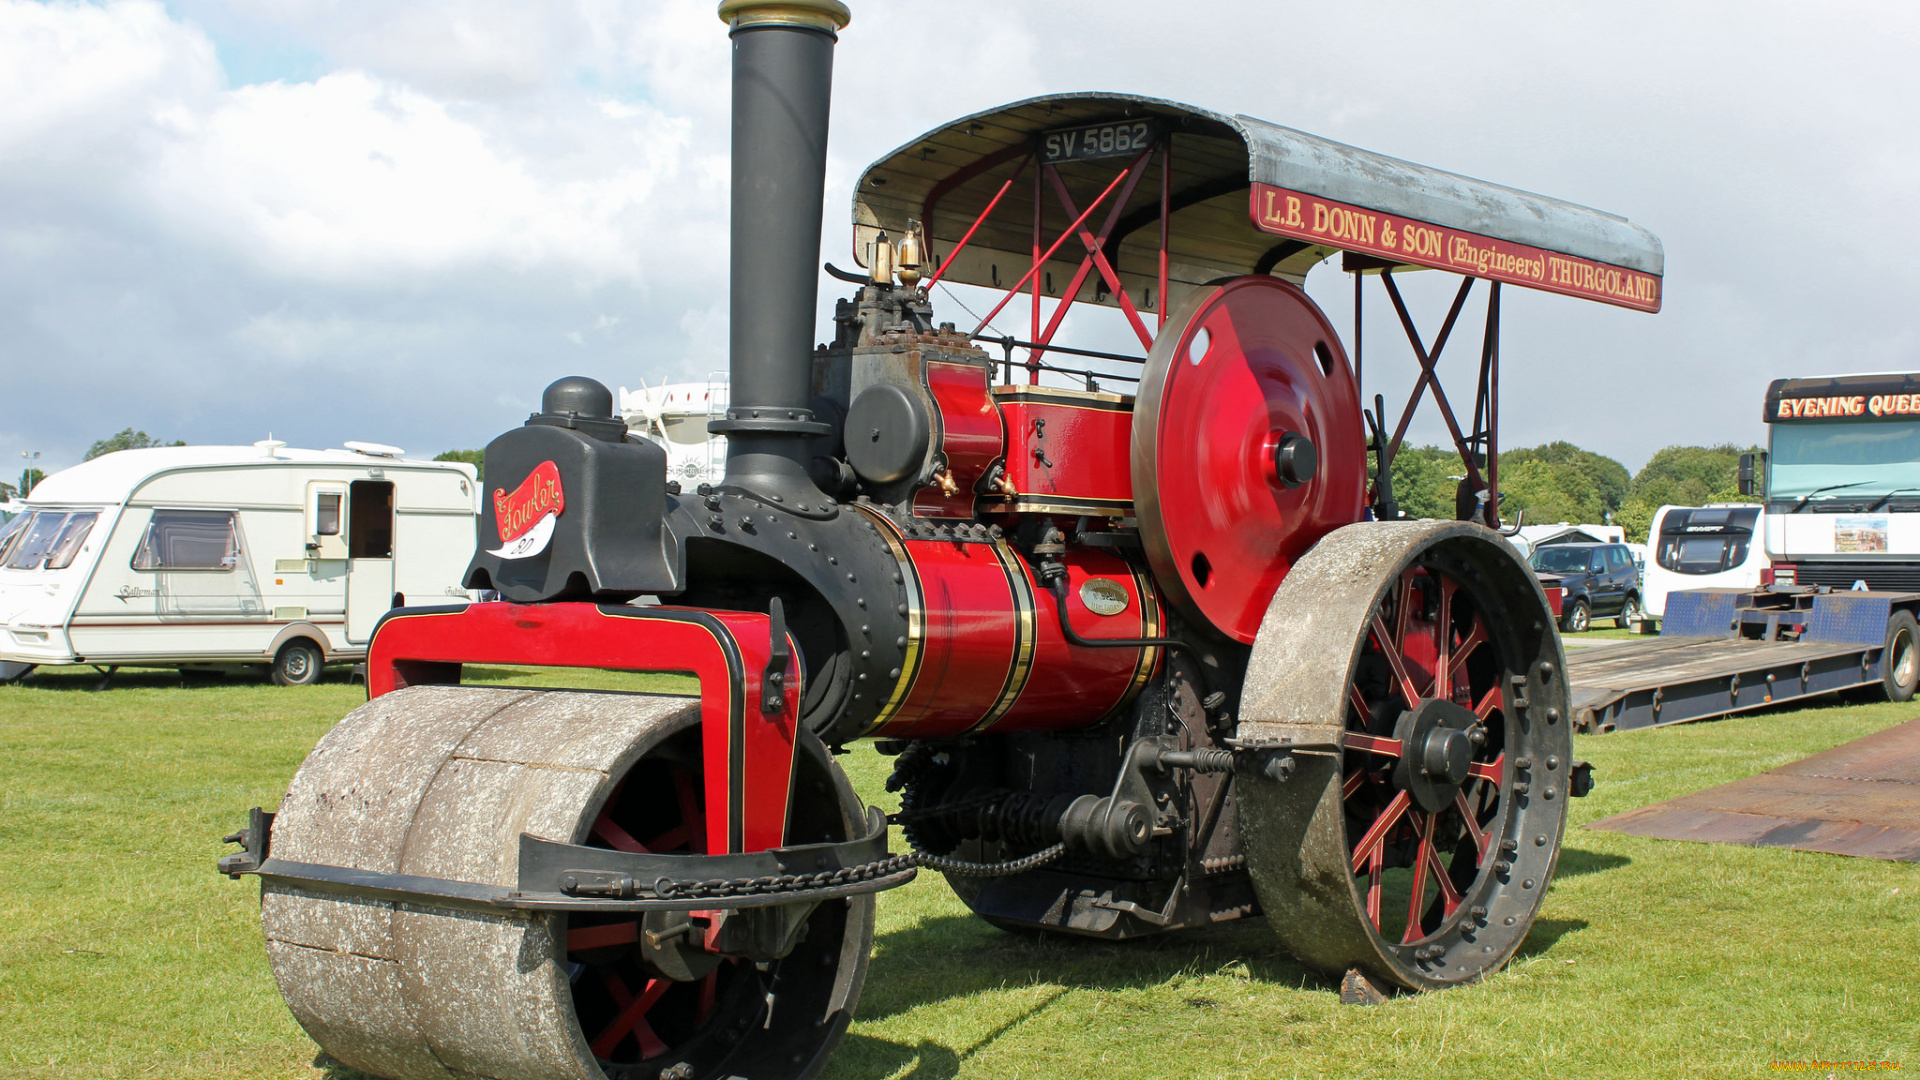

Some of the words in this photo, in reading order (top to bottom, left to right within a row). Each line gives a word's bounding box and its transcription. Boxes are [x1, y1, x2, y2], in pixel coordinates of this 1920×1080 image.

[1046, 132, 1076, 158] SV
[1083, 123, 1148, 154] 5862
[1265, 191, 1305, 229] L.B.
[1313, 203, 1376, 244] DONN
[1381, 220, 1397, 248] &
[1403, 225, 1443, 257] SON
[1448, 235, 1545, 281] (Engineers)
[1549, 257, 1657, 302] THURGOLAND
[1777, 396, 1865, 417] EVENING
[497, 474, 559, 540] Fowler
